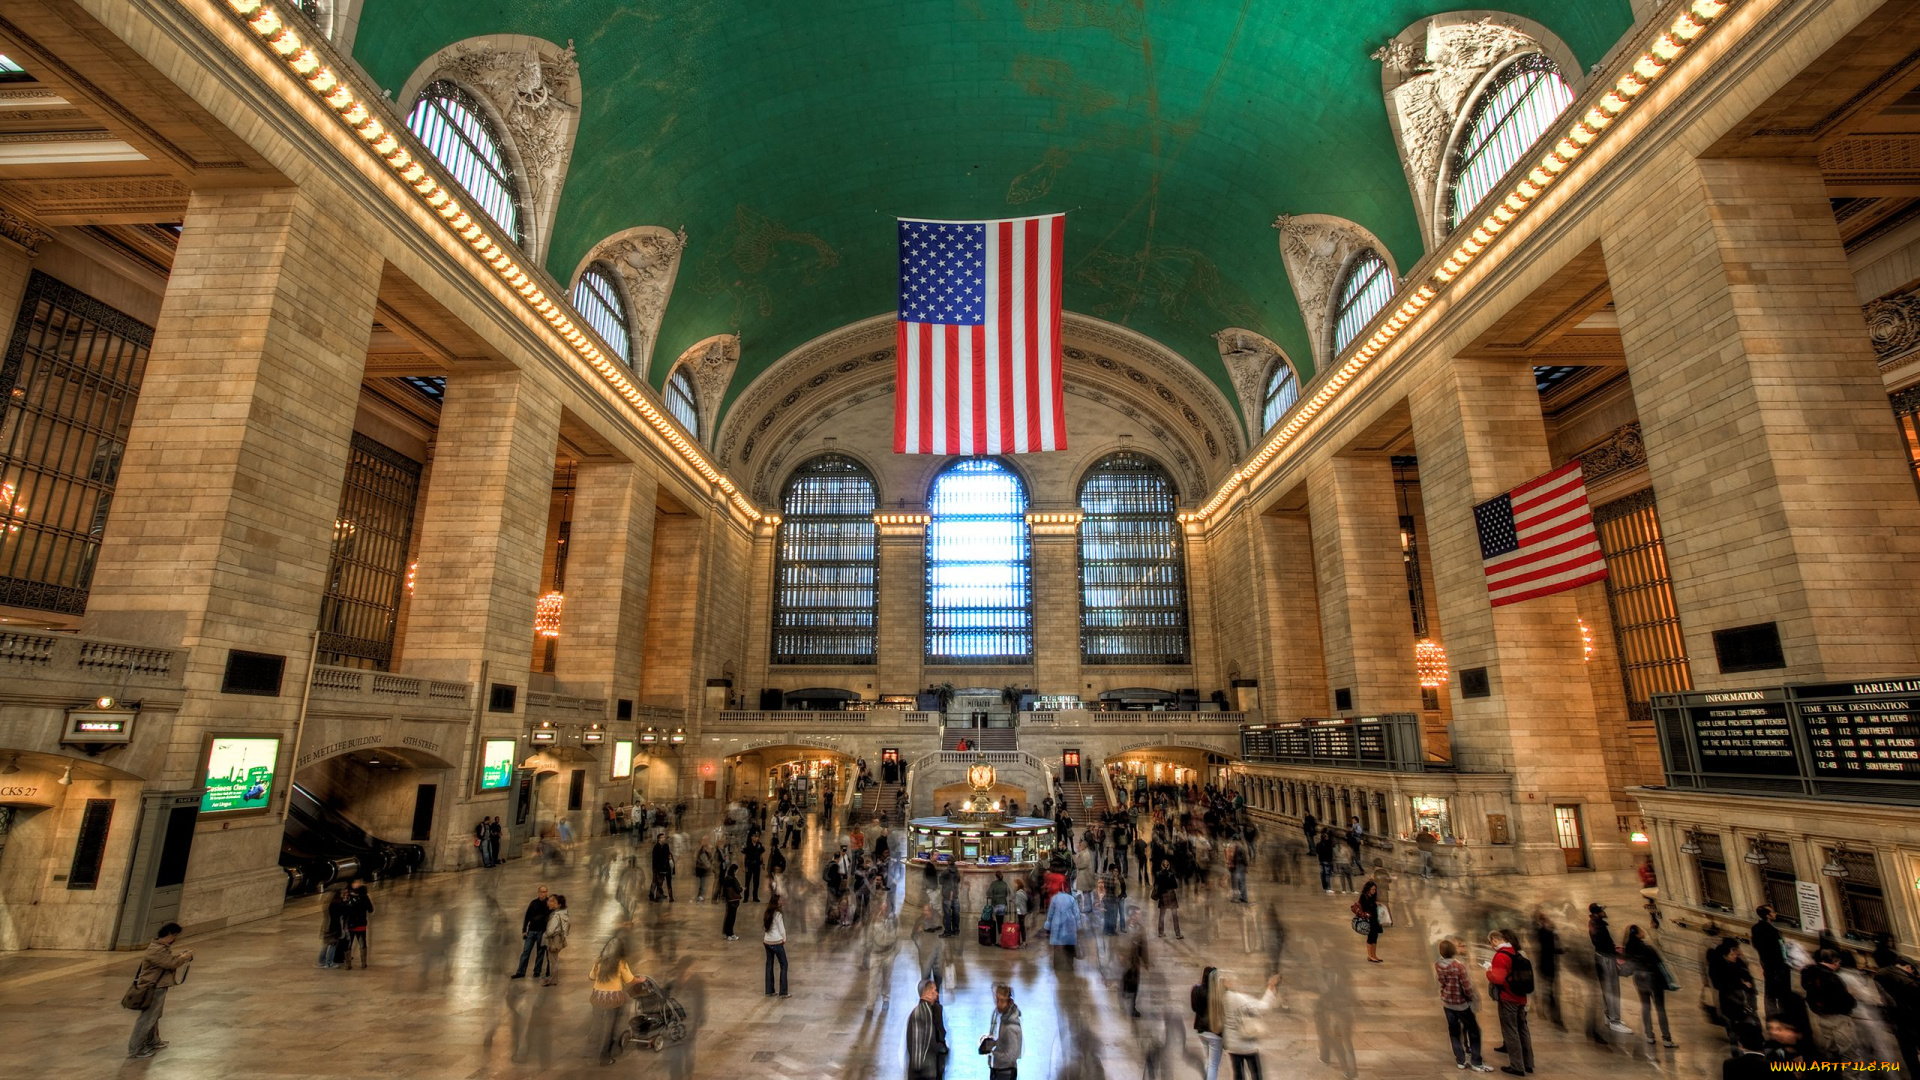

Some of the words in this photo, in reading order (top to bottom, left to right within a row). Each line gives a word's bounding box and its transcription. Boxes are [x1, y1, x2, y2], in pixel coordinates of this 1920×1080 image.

[1853, 682, 1905, 694] HARLEM
[1705, 691, 1764, 703] INFORMATION
[1802, 705, 1822, 713] TIME
[1826, 704, 1846, 712] TRK
[1849, 701, 1910, 711] DESTINATION
[1754, 718, 1787, 726] UNATTENDED
[1881, 714, 1909, 723] PLAINS
[81, 723, 109, 731] TRACK
[1856, 726, 1894, 735] SOUTHEAST
[1765, 728, 1789, 736] REMOVED
[313, 740, 347, 759] METLIFE
[348, 735, 382, 748] BUILDING
[402, 736, 418, 747] 45TH
[418, 739, 440, 752] STREET
[799, 739, 829, 749] LEXINGTON
[1120, 741, 1151, 752] LEXINGTON
[1732, 739, 1751, 747] POLICE
[1887, 738, 1915, 747] PLAINS
[1890, 750, 1918, 759] PLAINS
[1865, 762, 1904, 771] SOUTHEAST
[25, 787, 38, 797] 27
